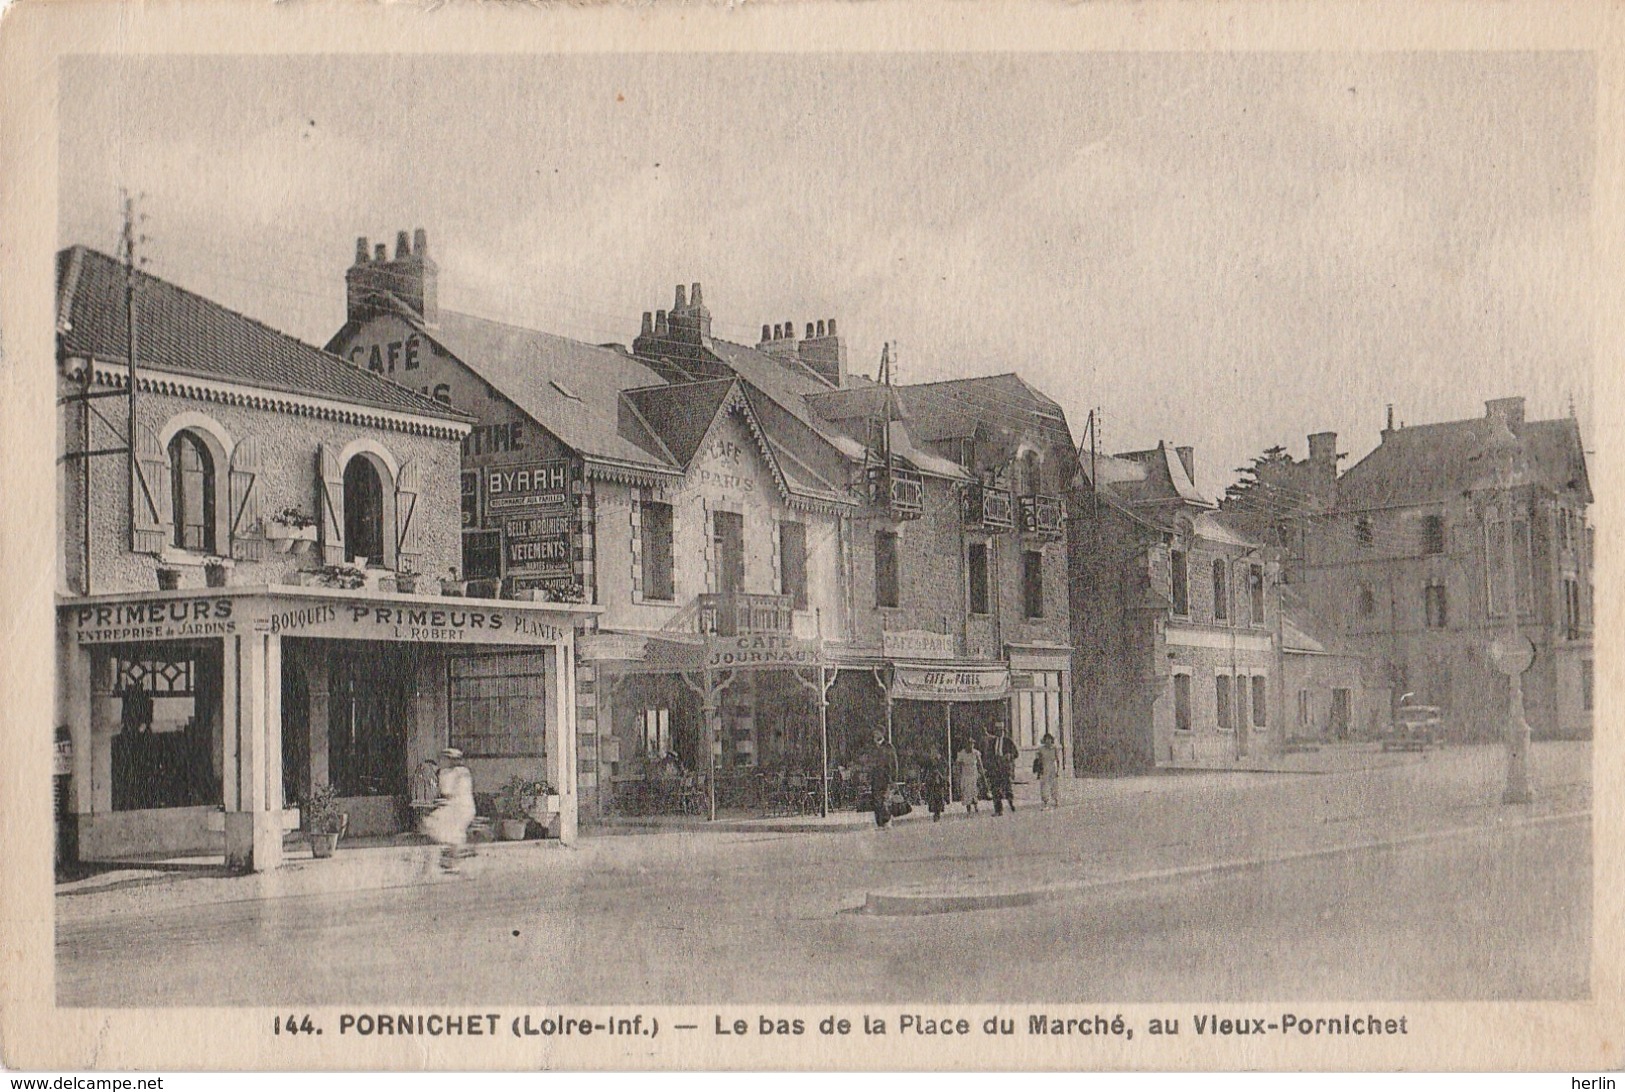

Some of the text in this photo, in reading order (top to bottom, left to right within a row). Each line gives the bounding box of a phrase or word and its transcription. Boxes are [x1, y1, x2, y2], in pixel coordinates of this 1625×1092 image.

[350, 333, 420, 375] CAFÉ
[490, 467, 565, 493] BYRRH
[701, 470, 753, 491] PARIS
[507, 520, 527, 537] BELLE
[77, 599, 234, 628] PRIMEURS
[271, 605, 335, 635] BOUQUETS
[350, 606, 504, 630] PRIMEURS
[77, 625, 162, 642] ENTREPRISE
[178, 621, 236, 636] JARDINS
[394, 626, 465, 641] L. ROBERT
[514, 615, 563, 641] PLANTES
[709, 650, 821, 666] JOURNAUX
[955, 673, 980, 685] PARIS
